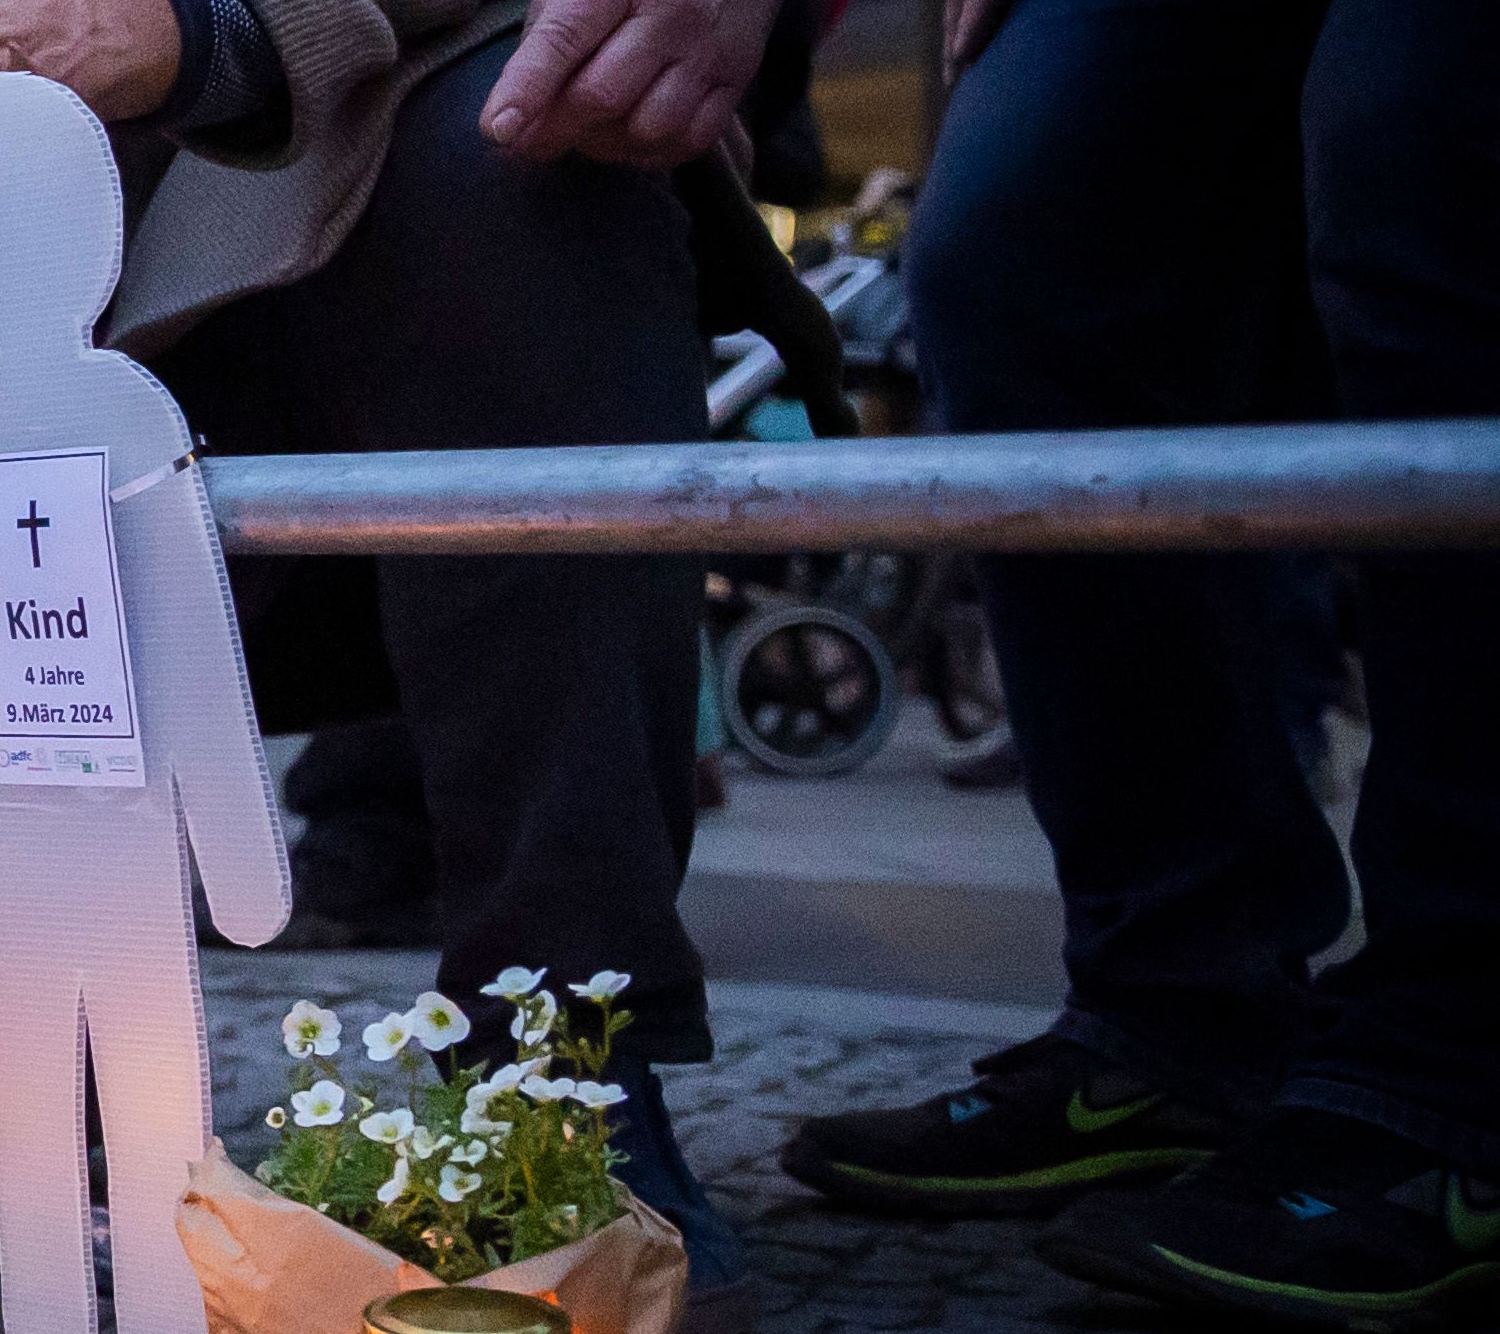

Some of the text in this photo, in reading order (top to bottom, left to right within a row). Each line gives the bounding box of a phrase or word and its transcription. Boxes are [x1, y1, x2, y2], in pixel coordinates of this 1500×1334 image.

[5, 596, 89, 640] Kind
[25, 665, 85, 685] 4 Jahre
[69, 704, 114, 723] 2024
